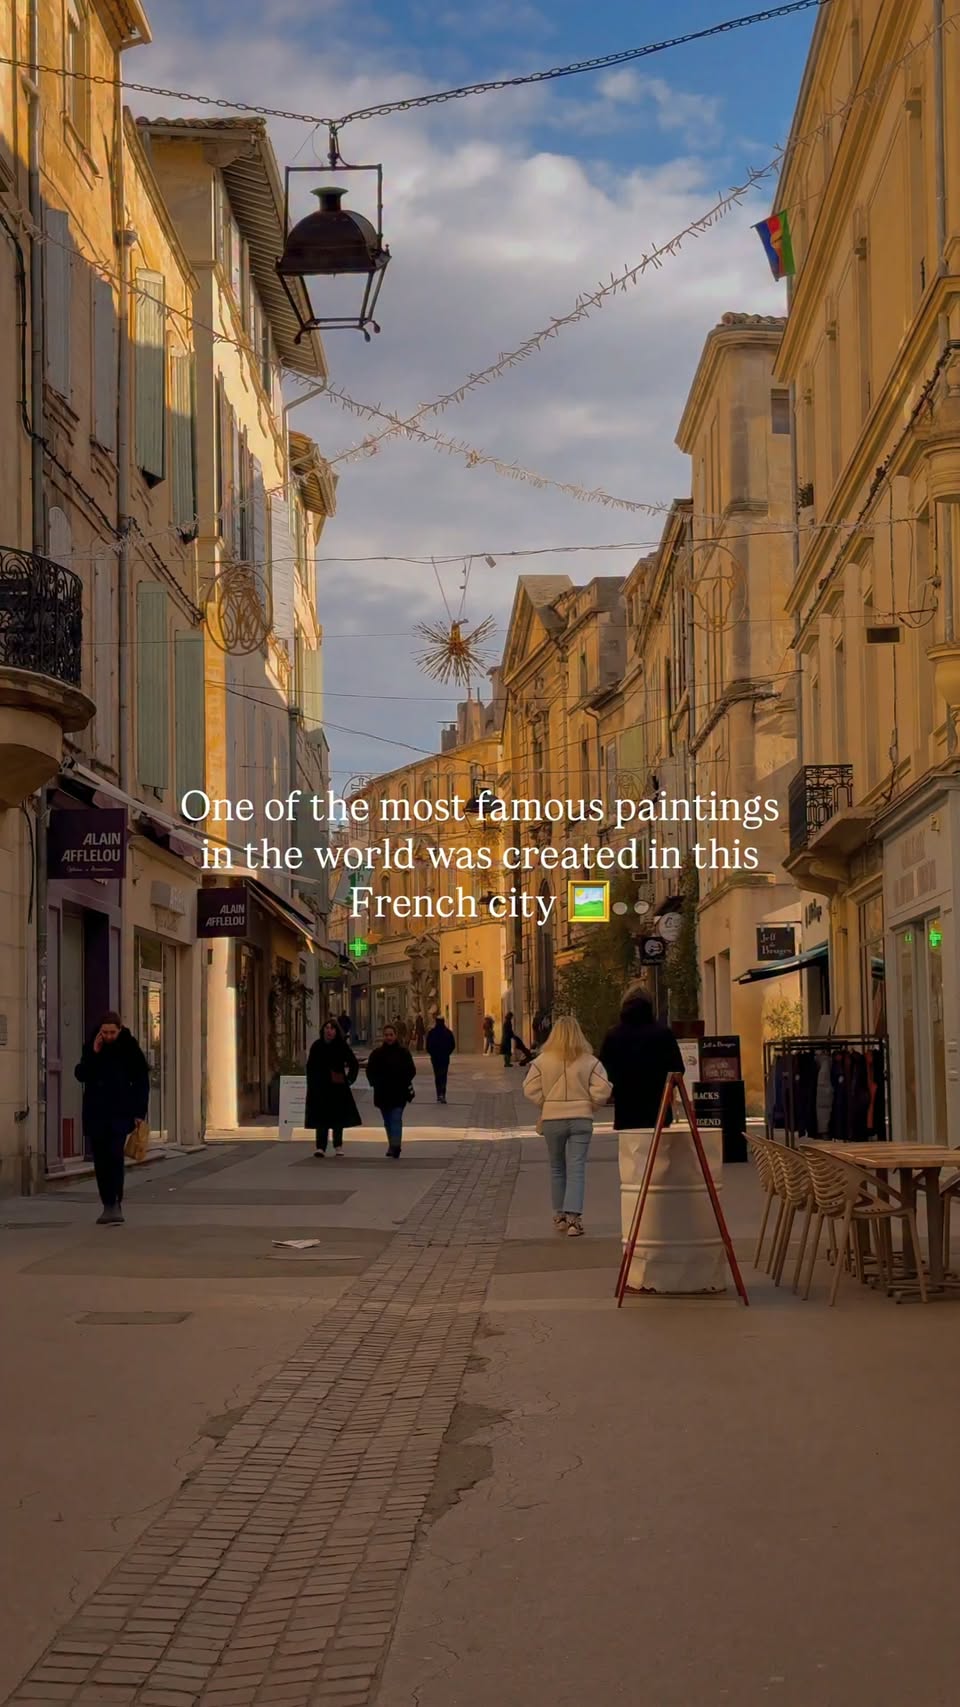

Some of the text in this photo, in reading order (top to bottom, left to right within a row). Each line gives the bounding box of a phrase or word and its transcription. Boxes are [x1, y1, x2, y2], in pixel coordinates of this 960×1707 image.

[82, 832, 121, 845] ALAIN
[61, 850, 121, 862] AFFLELOU
[219, 904, 245, 914] ALAIN
[205, 916, 245, 926] AFFLELOU
